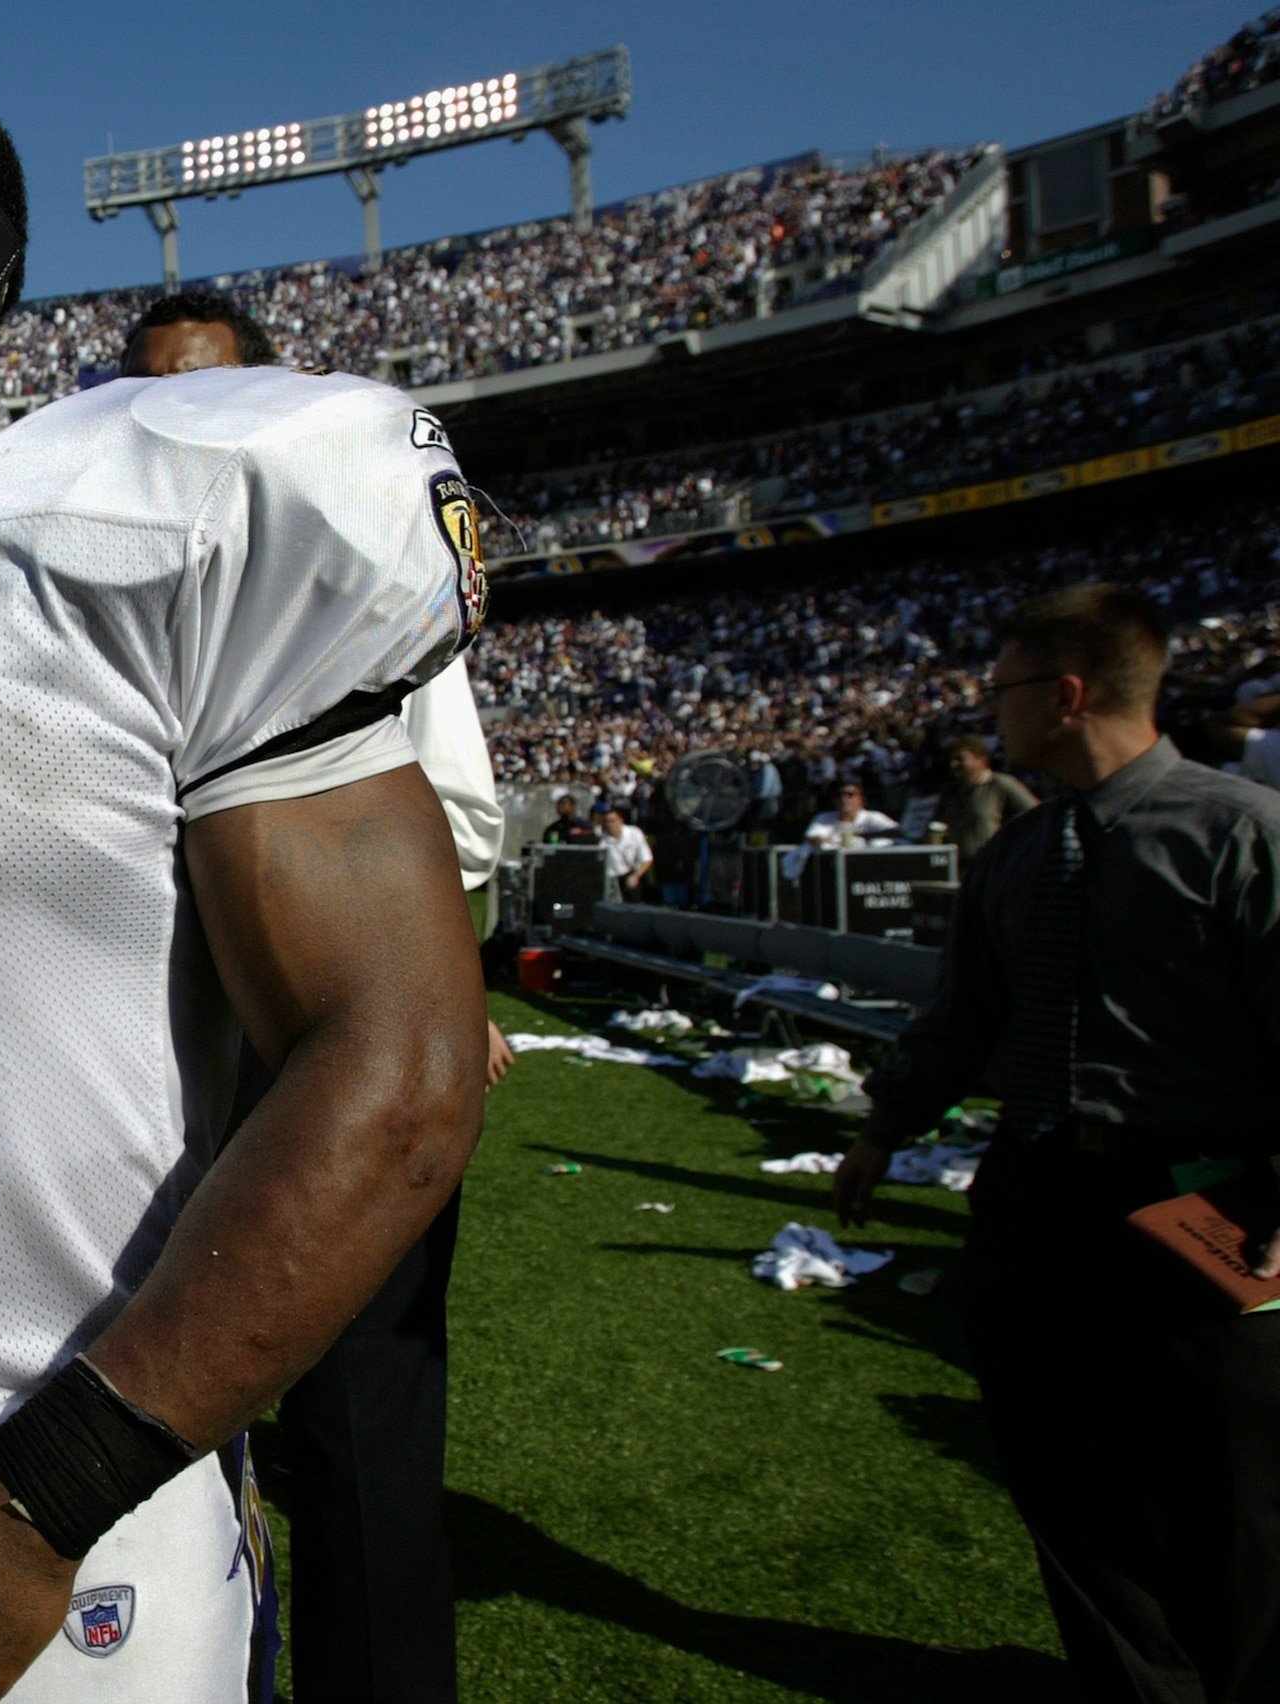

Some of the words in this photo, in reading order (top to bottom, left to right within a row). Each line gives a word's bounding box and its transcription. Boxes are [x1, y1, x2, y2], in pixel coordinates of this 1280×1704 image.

[863, 895, 915, 910] RAVE
[67, 1590, 129, 1614] QUIPMENT
[87, 1623, 120, 1645] NFL
